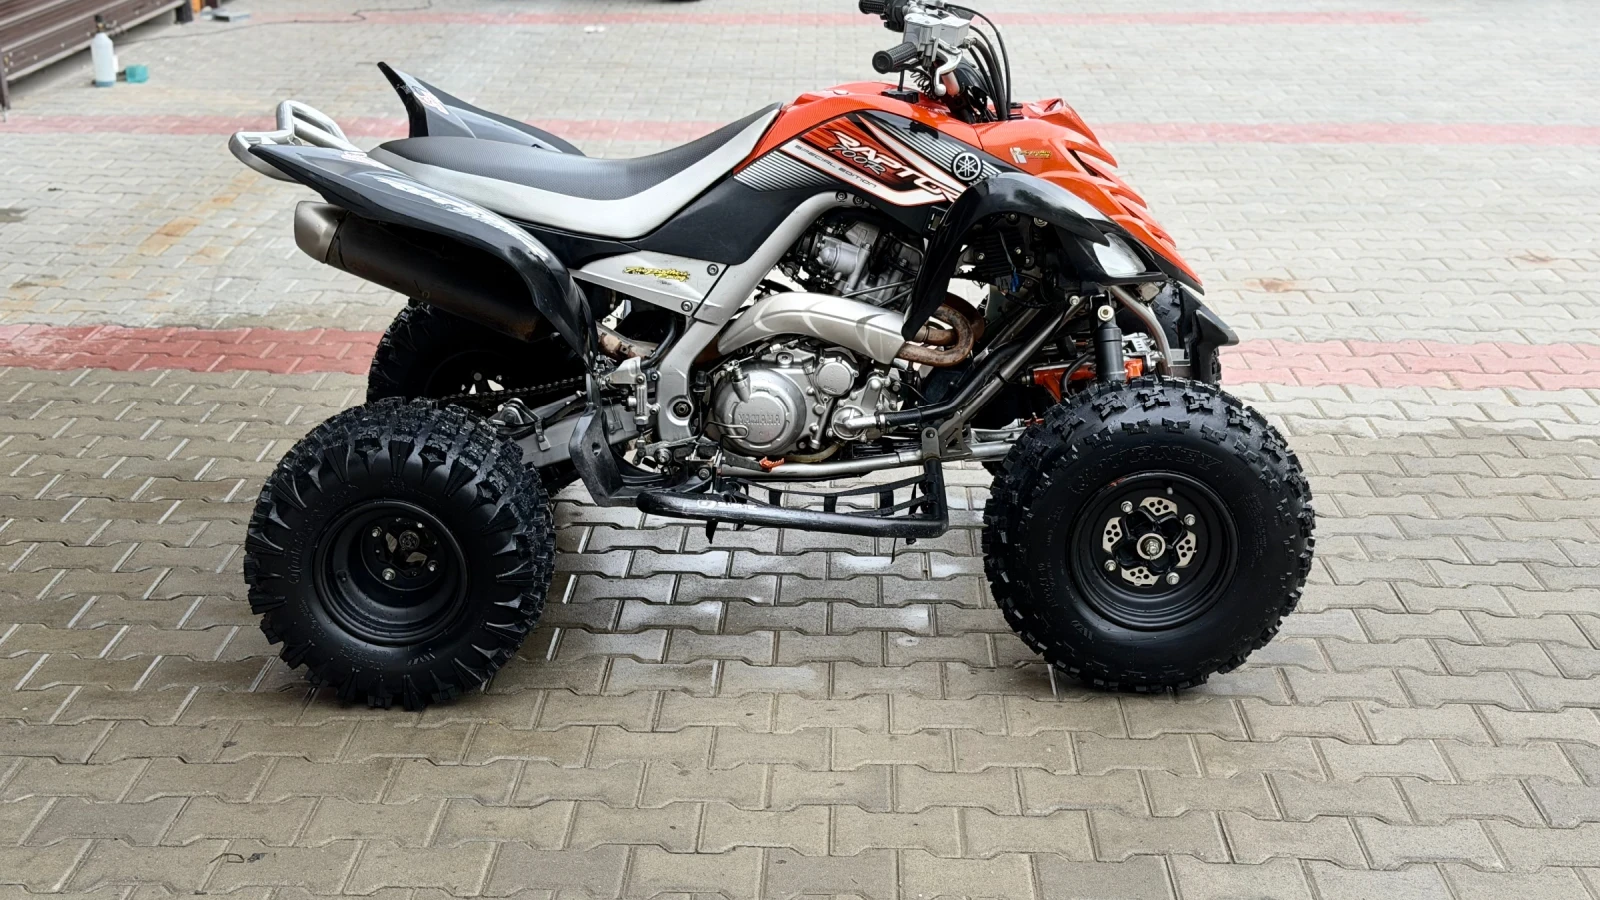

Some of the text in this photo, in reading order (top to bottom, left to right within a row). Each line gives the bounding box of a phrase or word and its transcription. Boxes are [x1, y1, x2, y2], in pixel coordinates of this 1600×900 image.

[794, 144, 877, 188] SPECIAL EDITION
[828, 143, 886, 176] 700R
